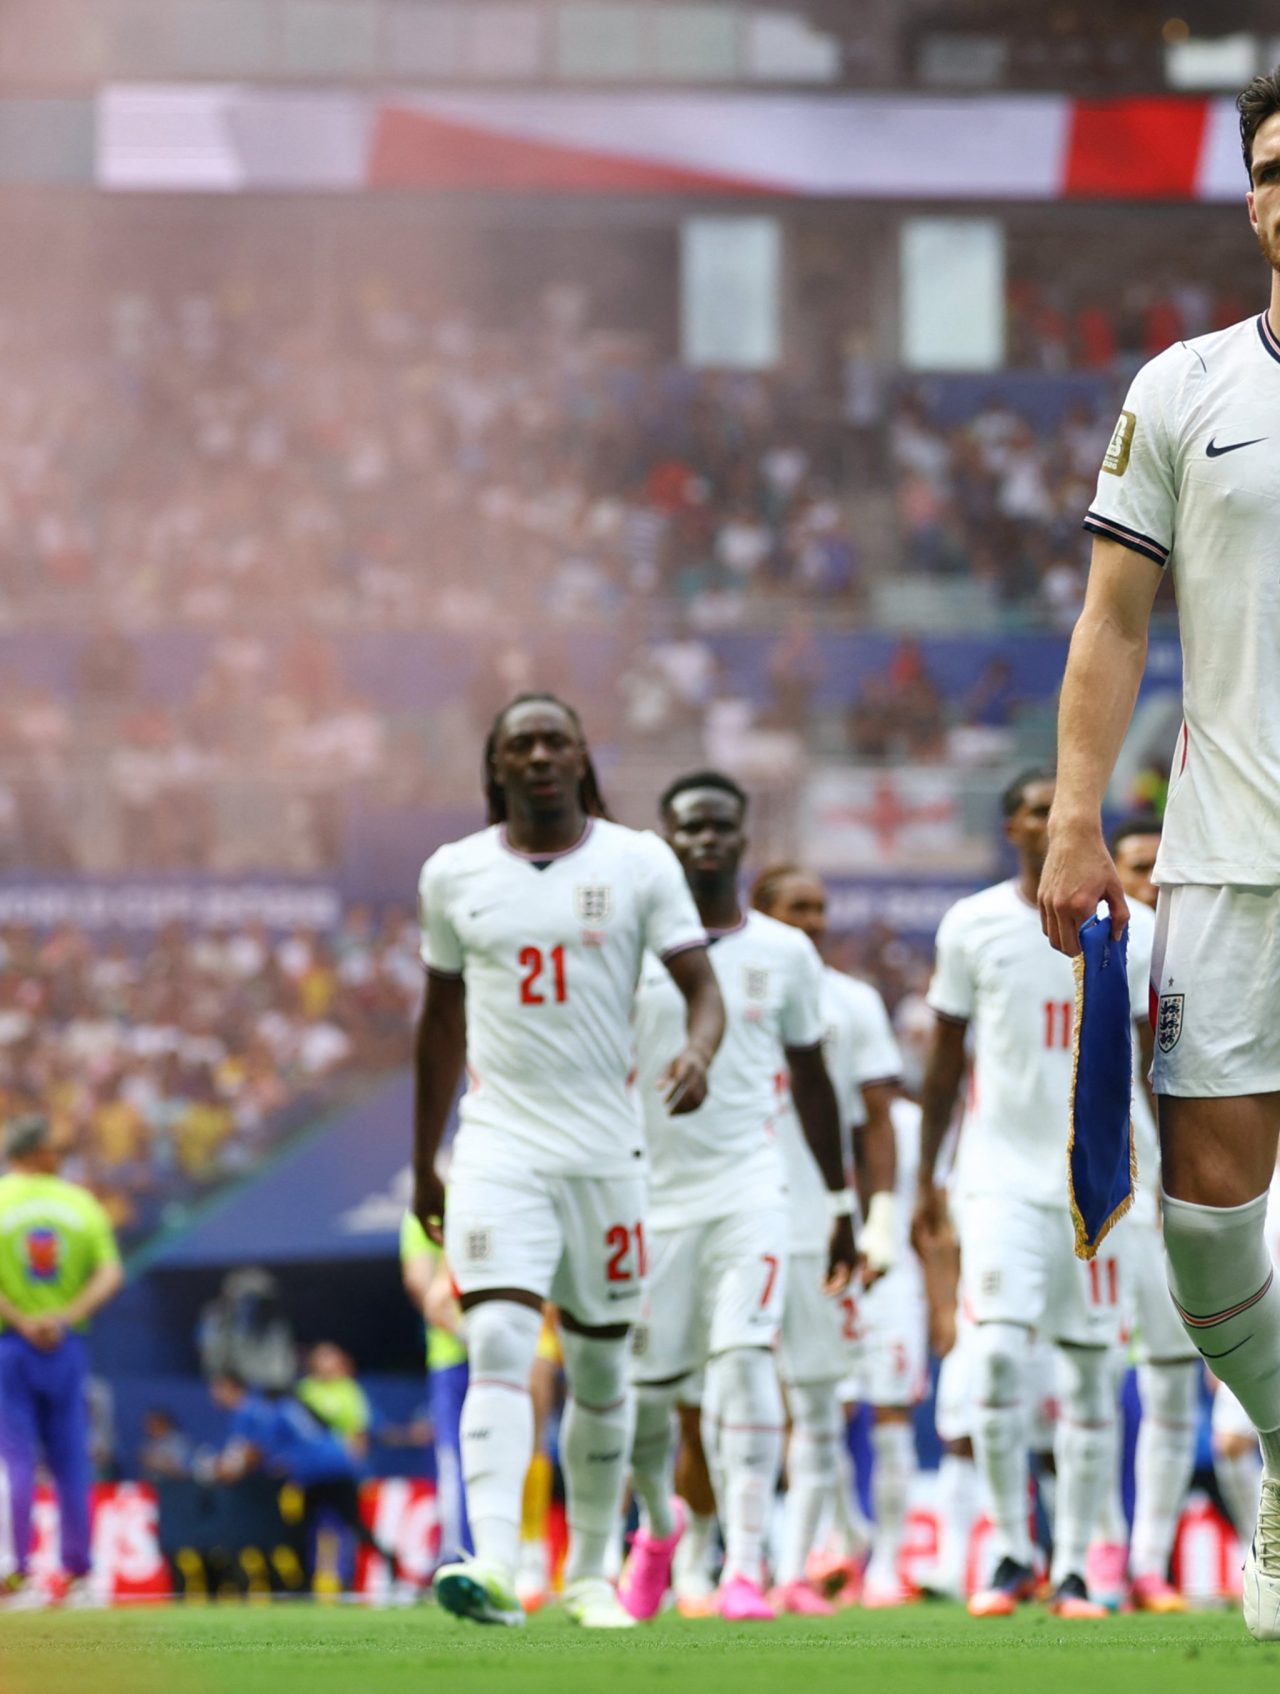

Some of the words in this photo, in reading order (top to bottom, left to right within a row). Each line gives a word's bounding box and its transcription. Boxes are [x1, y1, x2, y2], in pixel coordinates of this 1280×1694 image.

[518, 945, 568, 1006] 21
[1044, 1001, 1073, 1049] 11
[606, 1222, 647, 1282] 21
[761, 1254, 779, 1306] 7
[1088, 1257, 1118, 1304] 11
